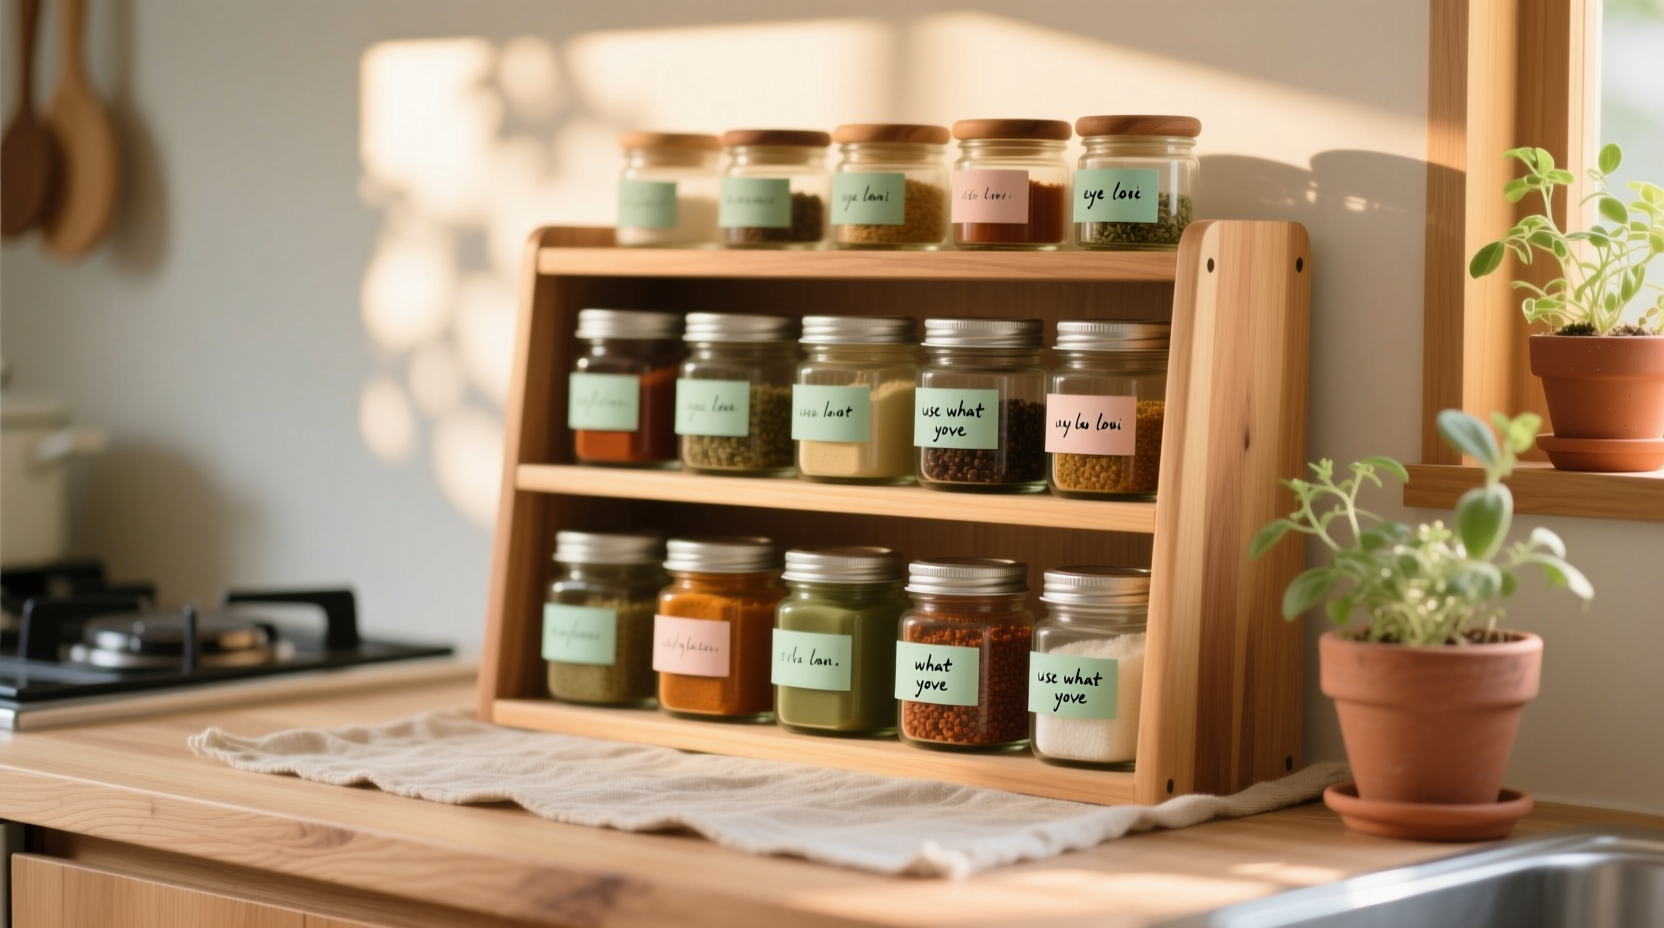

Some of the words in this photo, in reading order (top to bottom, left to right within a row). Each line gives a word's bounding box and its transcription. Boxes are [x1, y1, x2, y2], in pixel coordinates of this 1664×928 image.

[922, 405, 941, 418] use
[946, 399, 985, 418] what
[933, 424, 967, 442] yove
[915, 653, 953, 672] what
[1037, 670, 1058, 684] use
[1063, 668, 1103, 687] what
[915, 677, 948, 698] yove
[1054, 691, 1088, 712] yove
